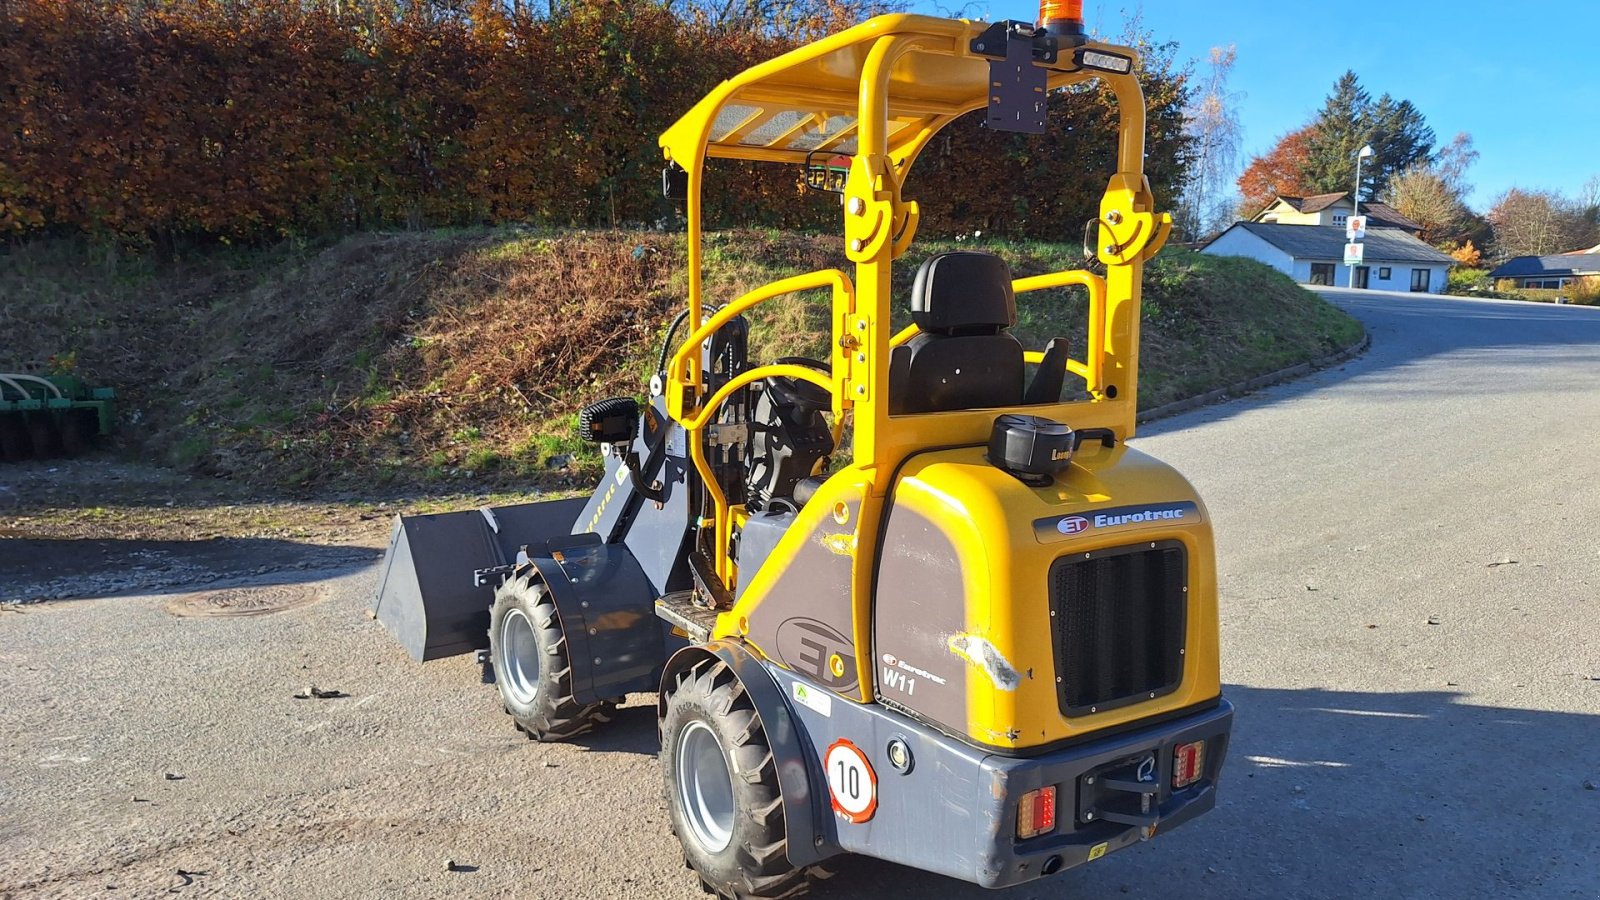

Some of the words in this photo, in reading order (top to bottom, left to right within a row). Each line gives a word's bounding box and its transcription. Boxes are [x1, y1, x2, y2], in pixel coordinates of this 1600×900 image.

[1061, 517, 1085, 534] ET
[1094, 508, 1184, 528] Eurotrac
[883, 666, 915, 696] W11
[837, 760, 860, 800] 10
